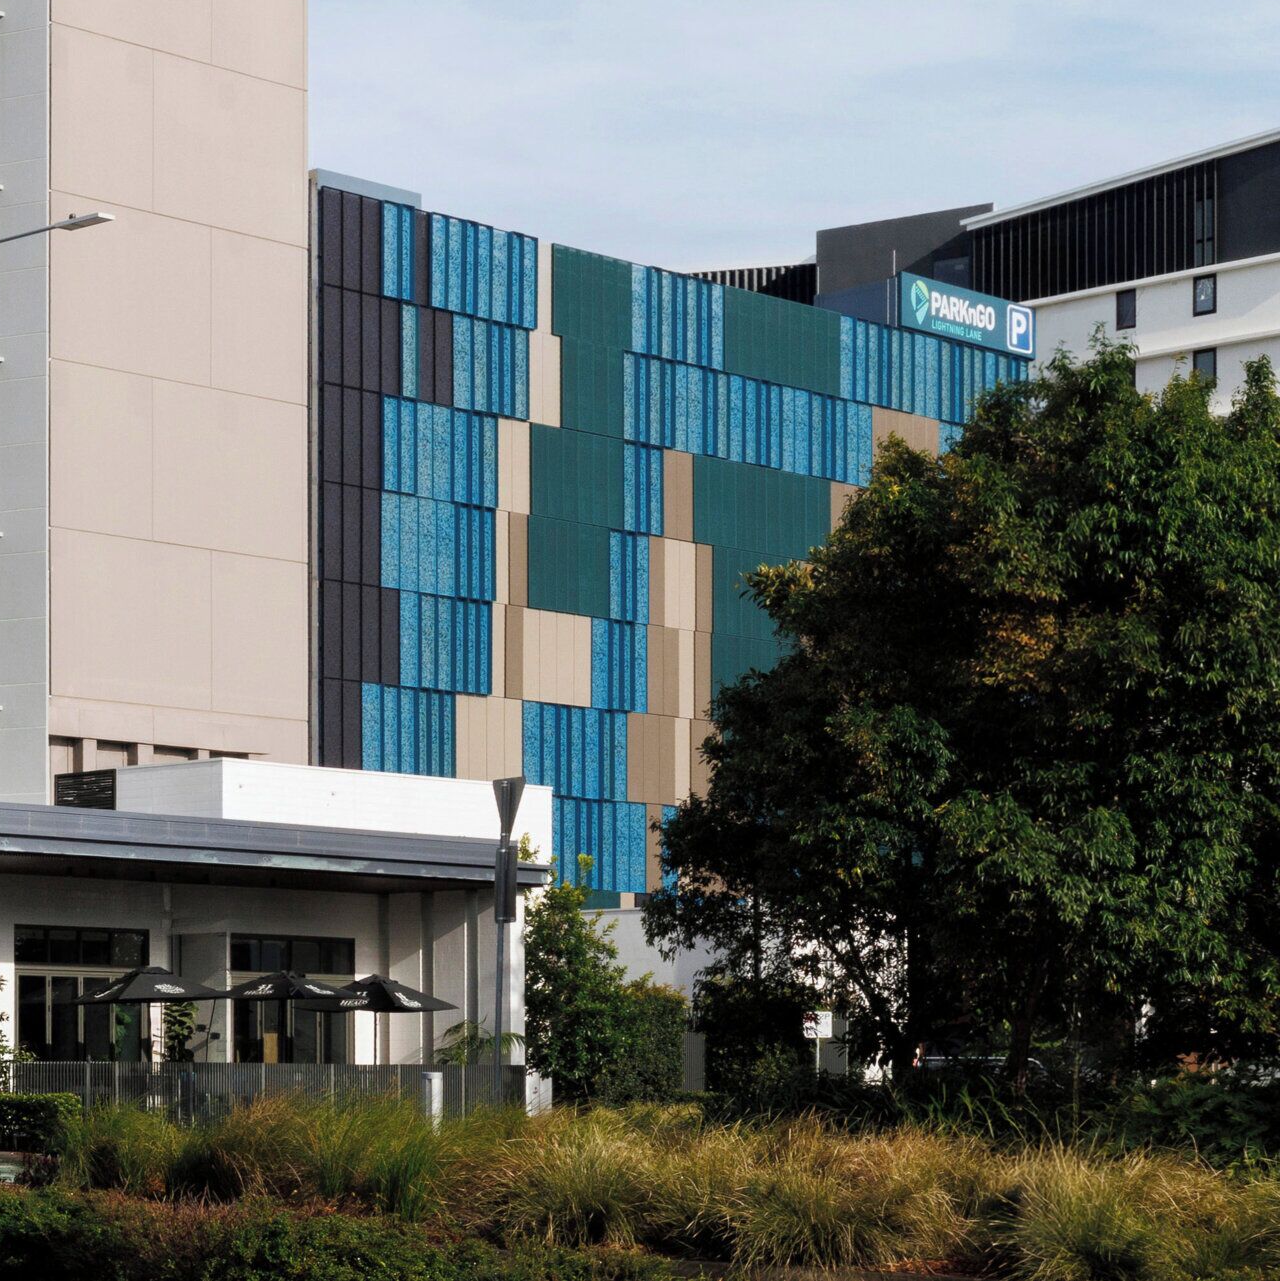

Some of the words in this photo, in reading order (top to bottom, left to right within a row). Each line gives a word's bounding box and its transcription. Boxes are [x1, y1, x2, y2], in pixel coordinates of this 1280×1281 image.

[930, 291, 996, 331] PARKnGO
[1011, 312, 1027, 345] P
[931, 319, 965, 338] LIGHTNING
[965, 327, 983, 341] LANE
